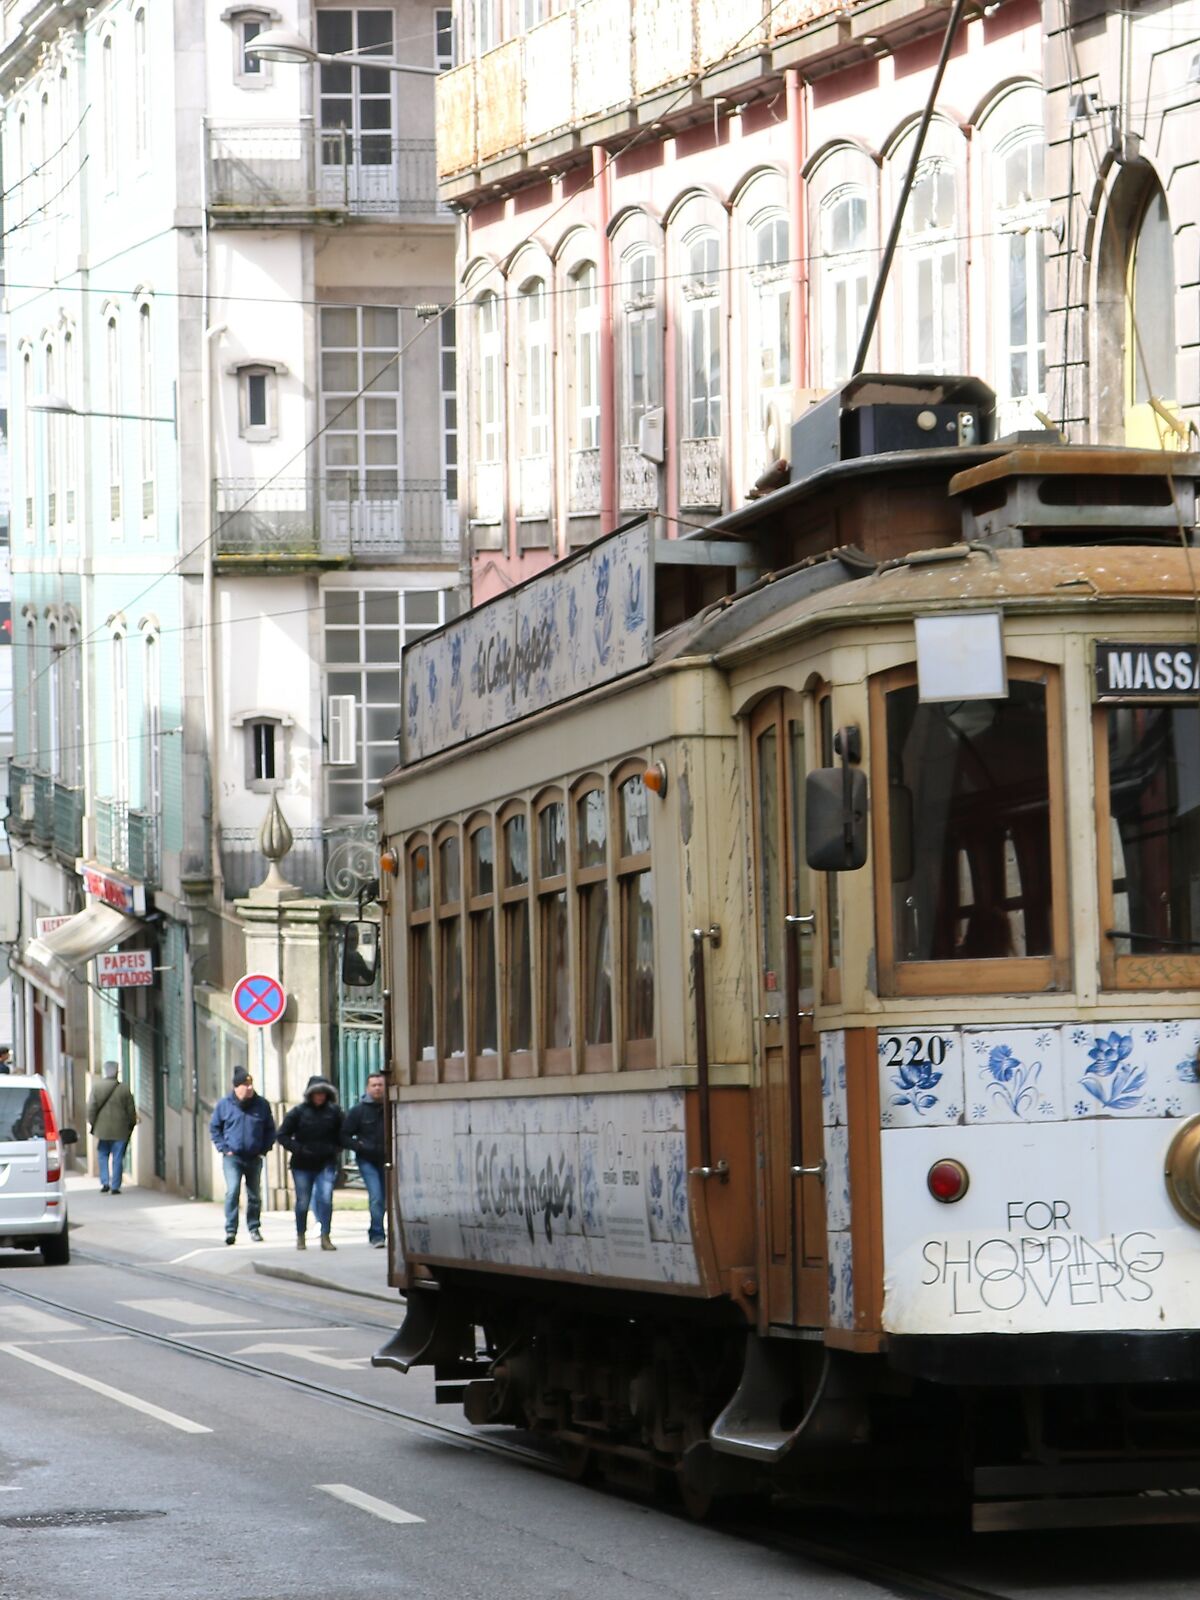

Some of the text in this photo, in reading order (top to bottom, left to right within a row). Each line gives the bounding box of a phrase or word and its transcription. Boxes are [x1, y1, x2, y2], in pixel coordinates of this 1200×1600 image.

[104, 953, 146, 969] PAPEIS
[100, 971, 152, 986] PINTADOS
[886, 1035, 947, 1067] 220
[1007, 1200, 1072, 1232] FOR
[921, 1231, 1165, 1285] SHOPPING
[953, 1260, 1154, 1315] LOVERS
